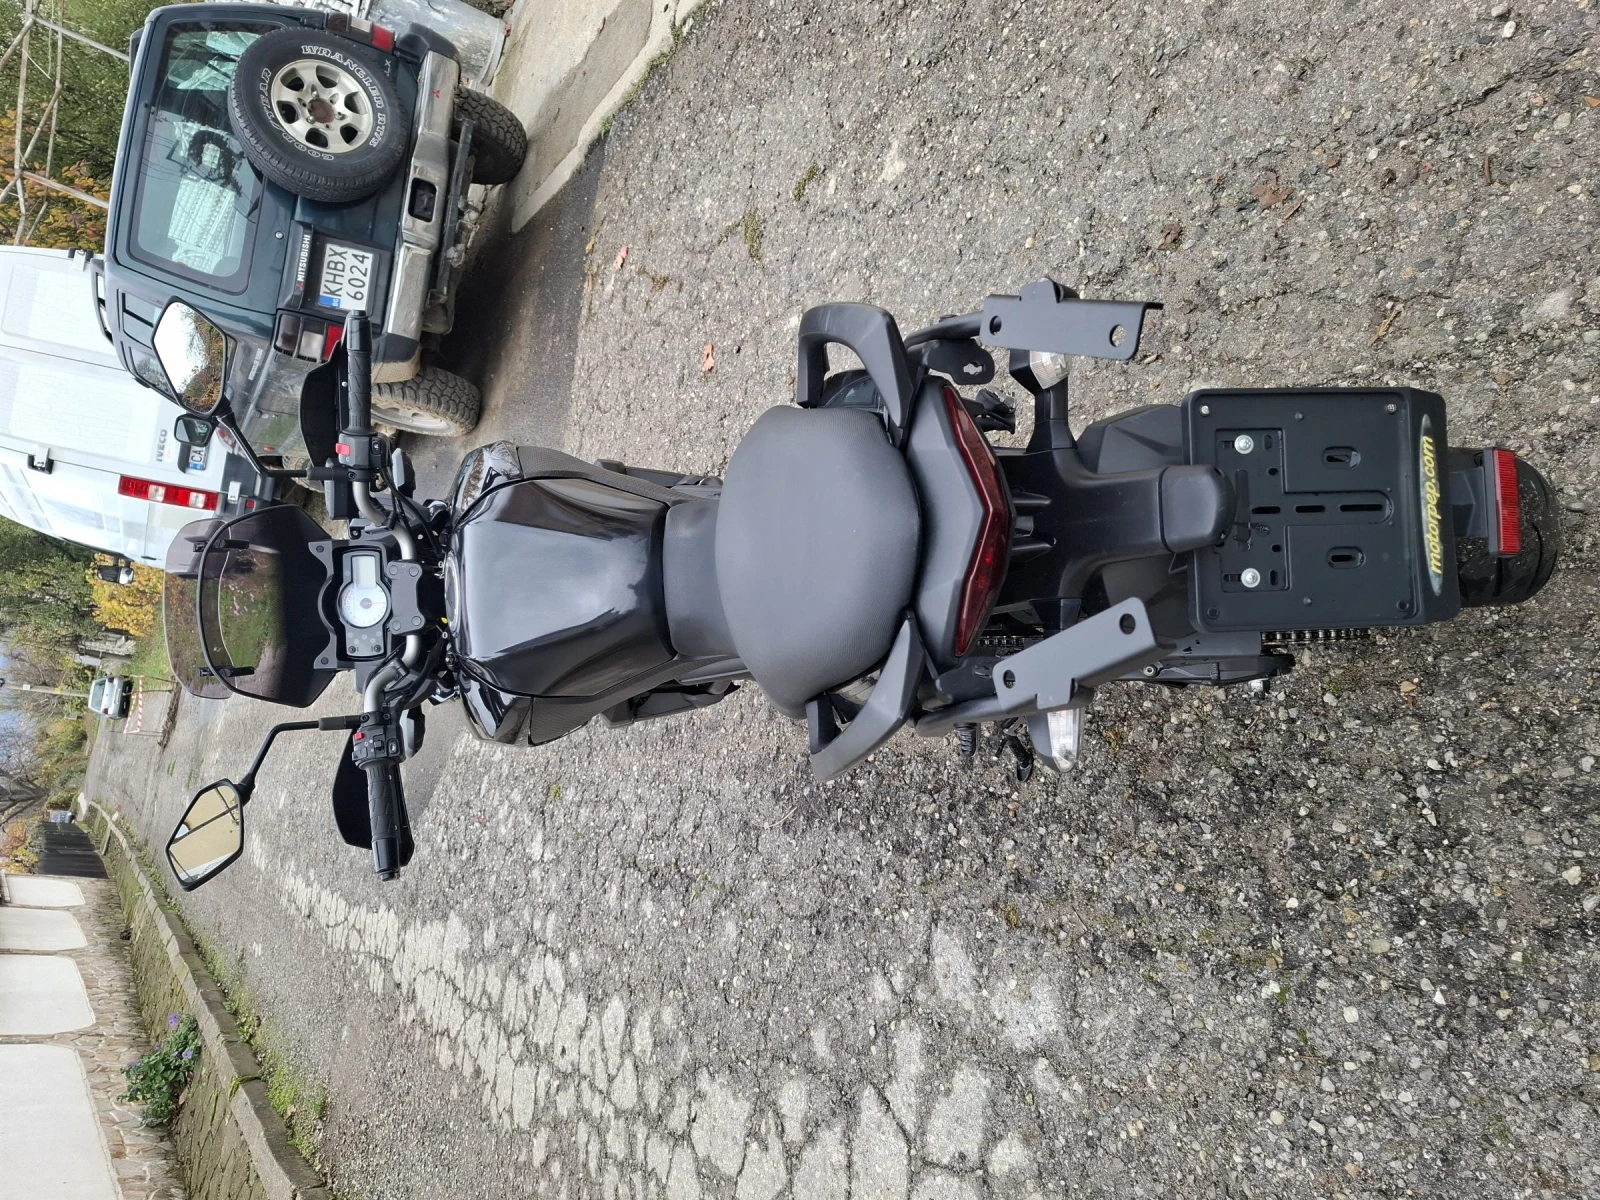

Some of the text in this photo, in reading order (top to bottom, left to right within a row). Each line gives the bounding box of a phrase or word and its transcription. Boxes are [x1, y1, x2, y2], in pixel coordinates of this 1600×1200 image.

[301, 45, 385, 109] WRANGLER
[384, 59, 392, 77] LX
[297, 234, 311, 282] MITSUBISHI
[323, 247, 348, 297] KHBX
[346, 253, 370, 301] 6024
[156, 429, 168, 463] IVECO
[1422, 435, 1442, 574] motorpep.com
